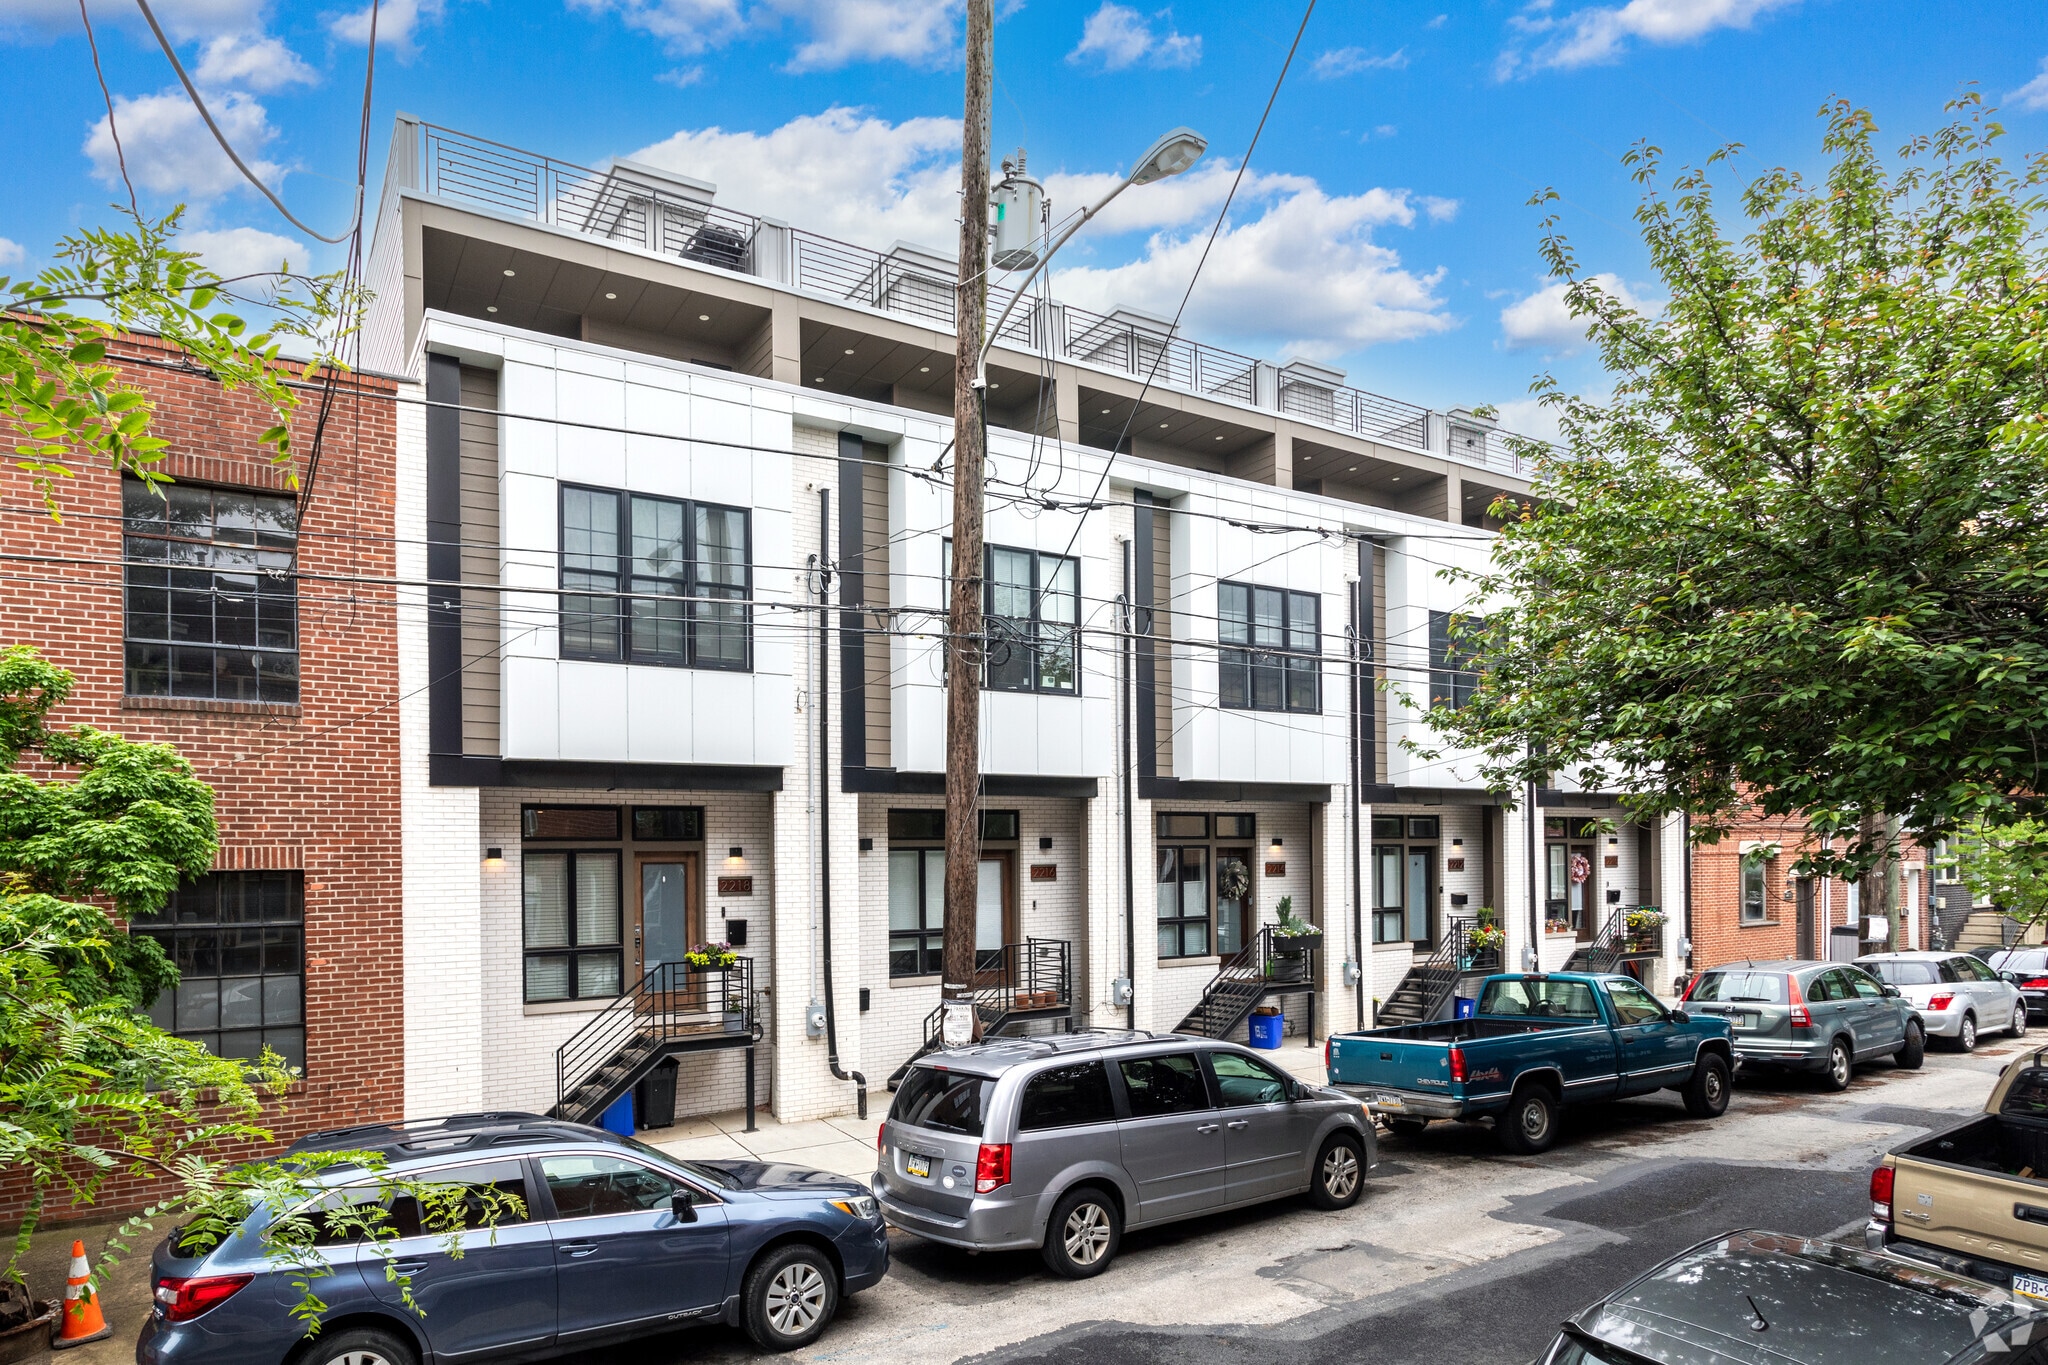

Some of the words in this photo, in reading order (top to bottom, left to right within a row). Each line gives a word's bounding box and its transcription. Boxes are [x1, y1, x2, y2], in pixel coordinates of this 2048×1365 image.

[1033, 866, 1056, 878] 2216
[720, 880, 751, 892] 2218
[1416, 1078, 1449, 1087] CHEVROLET
[668, 1309, 703, 1320] OUTBACK
